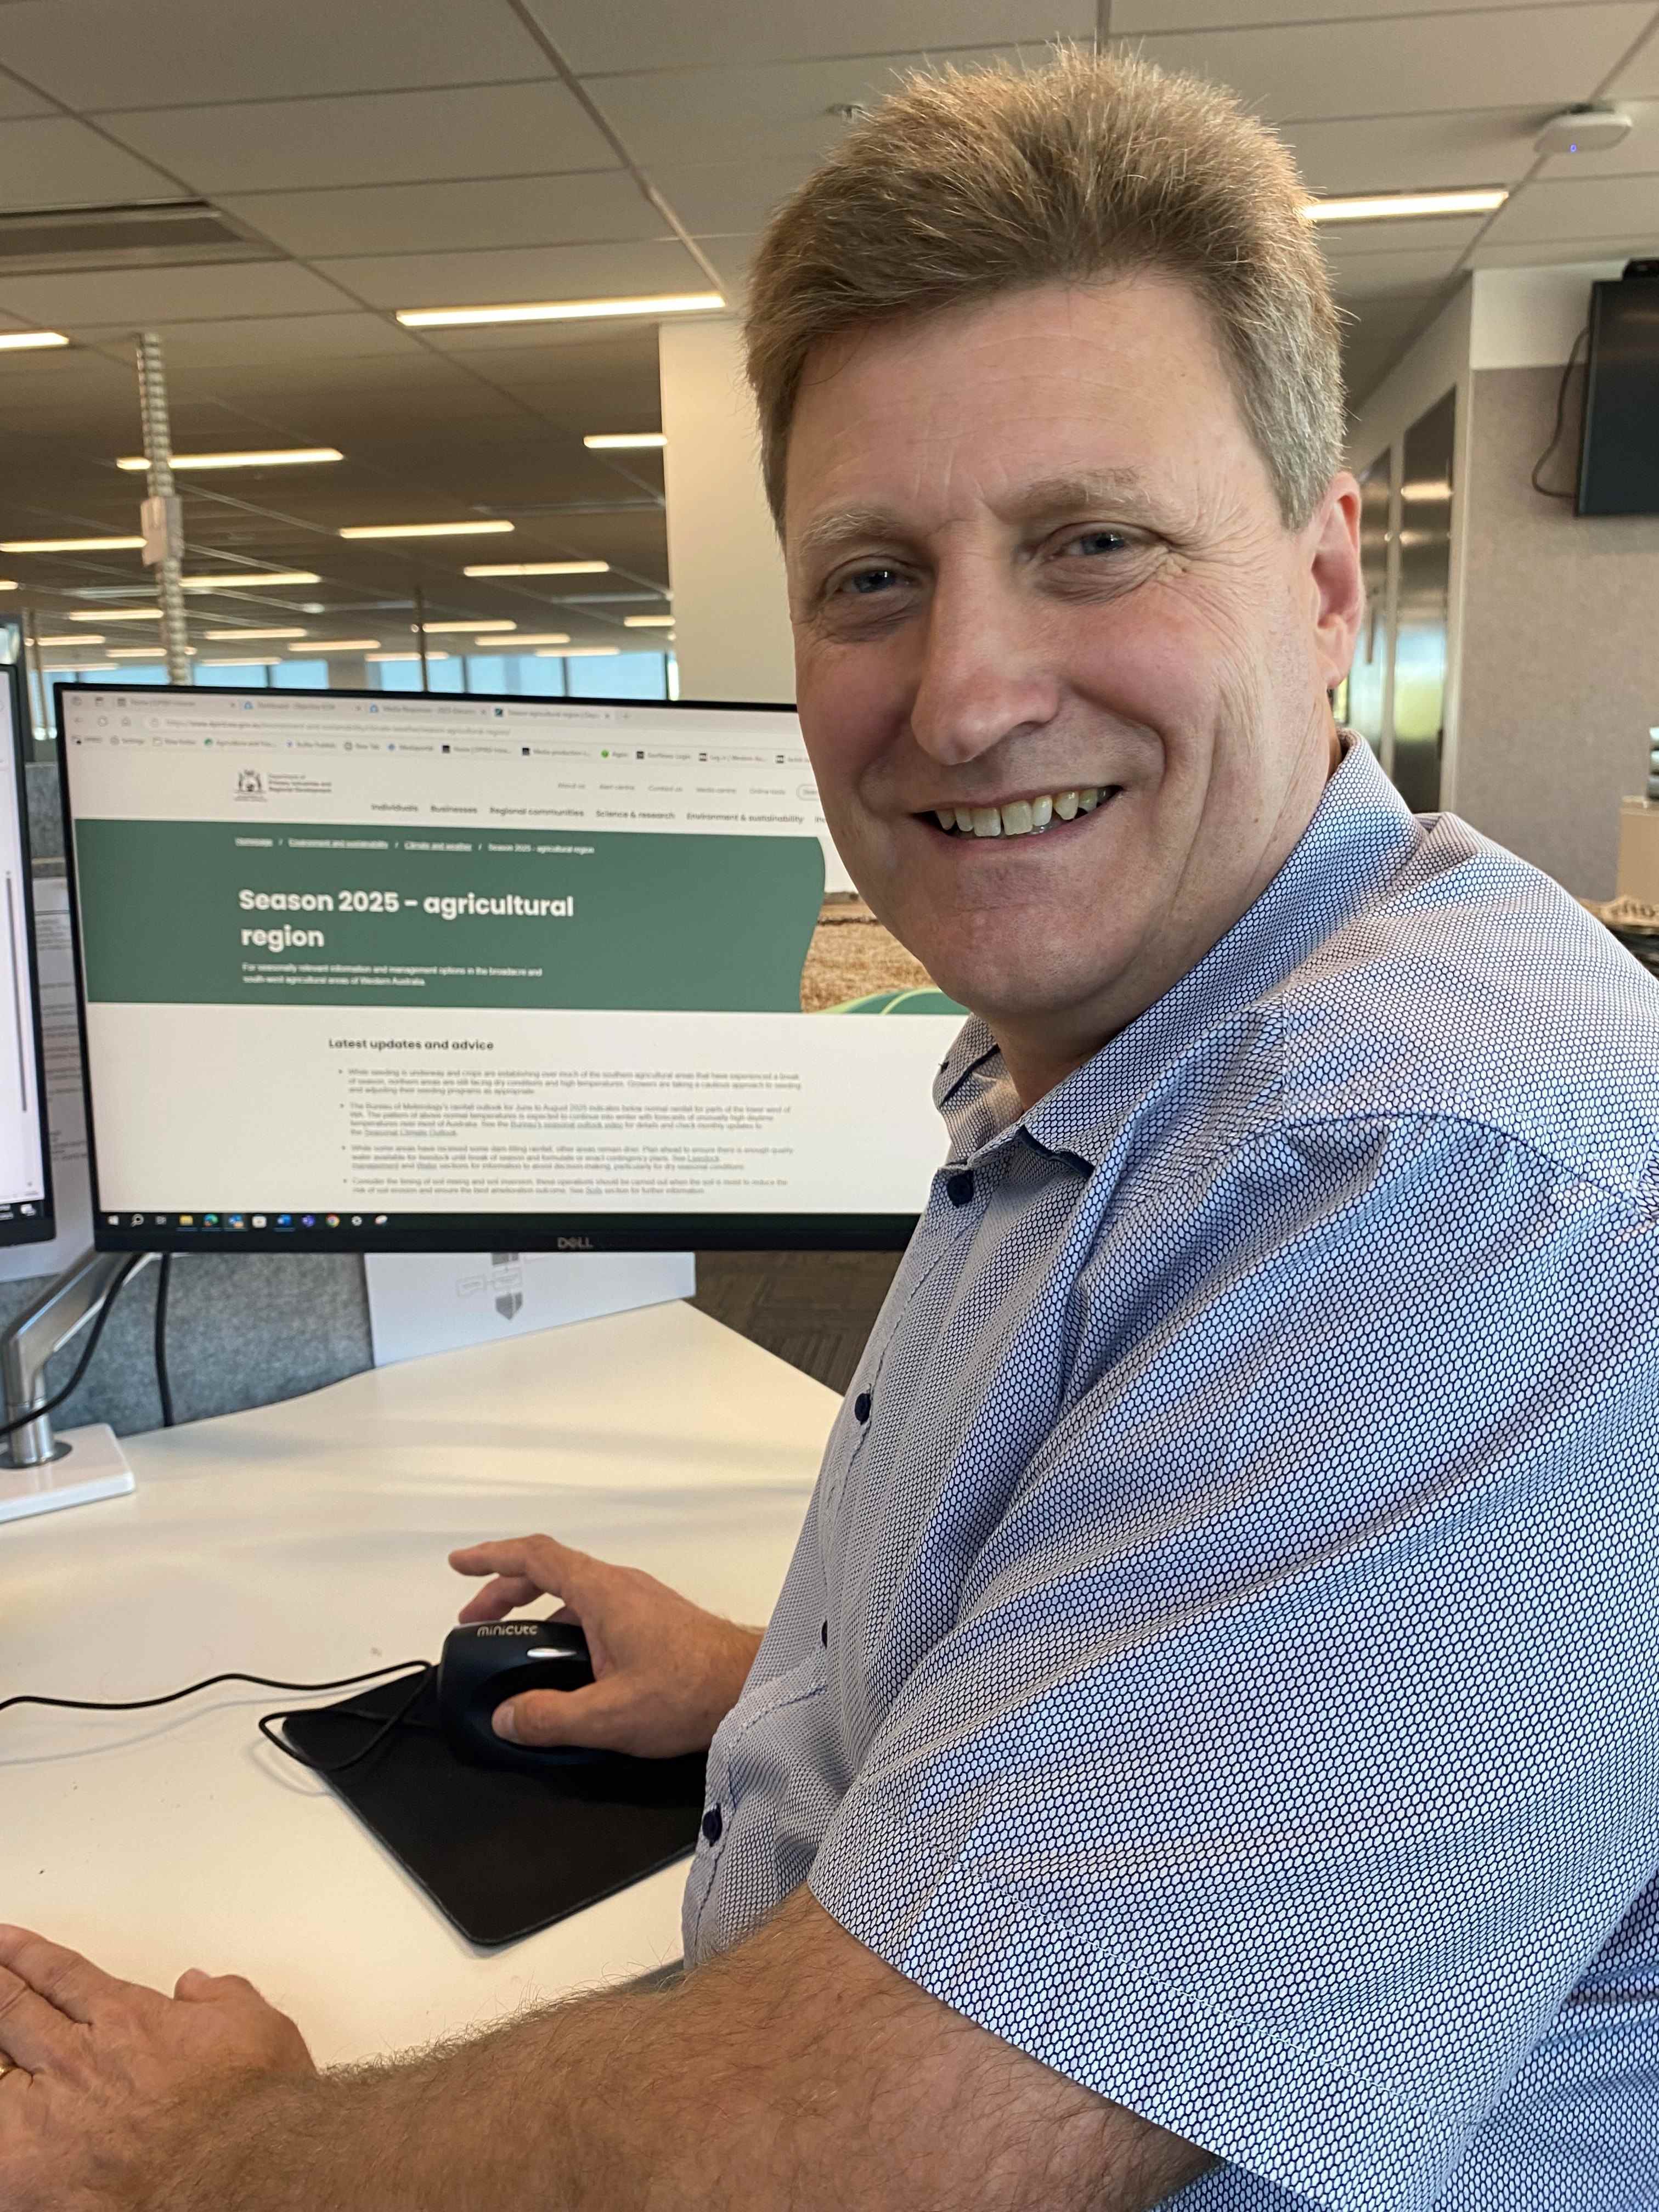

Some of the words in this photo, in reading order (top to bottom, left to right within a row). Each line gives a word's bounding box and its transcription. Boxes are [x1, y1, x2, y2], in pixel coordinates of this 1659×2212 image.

[370, 803, 418, 812] Individuals
[431, 805, 477, 814] Businesses
[490, 807, 526, 817] Regional
[528, 808, 584, 817] communities
[596, 810, 628, 818] Science
[639, 811, 675, 820] research
[686, 812, 738, 821] Environment
[749, 814, 804, 825] sustainability
[537, 844, 572, 854] agricultural
[574, 845, 594, 854] region
[238, 889, 334, 911] Season
[338, 891, 400, 913] 2025
[423, 893, 574, 920] agricultural
[240, 924, 325, 952] region
[328, 1039, 367, 1049] Latest
[370, 1039, 421, 1052] updates
[425, 1040, 449, 1050] and
[452, 1040, 494, 1051] advice
[557, 1237, 593, 1249] DELL
